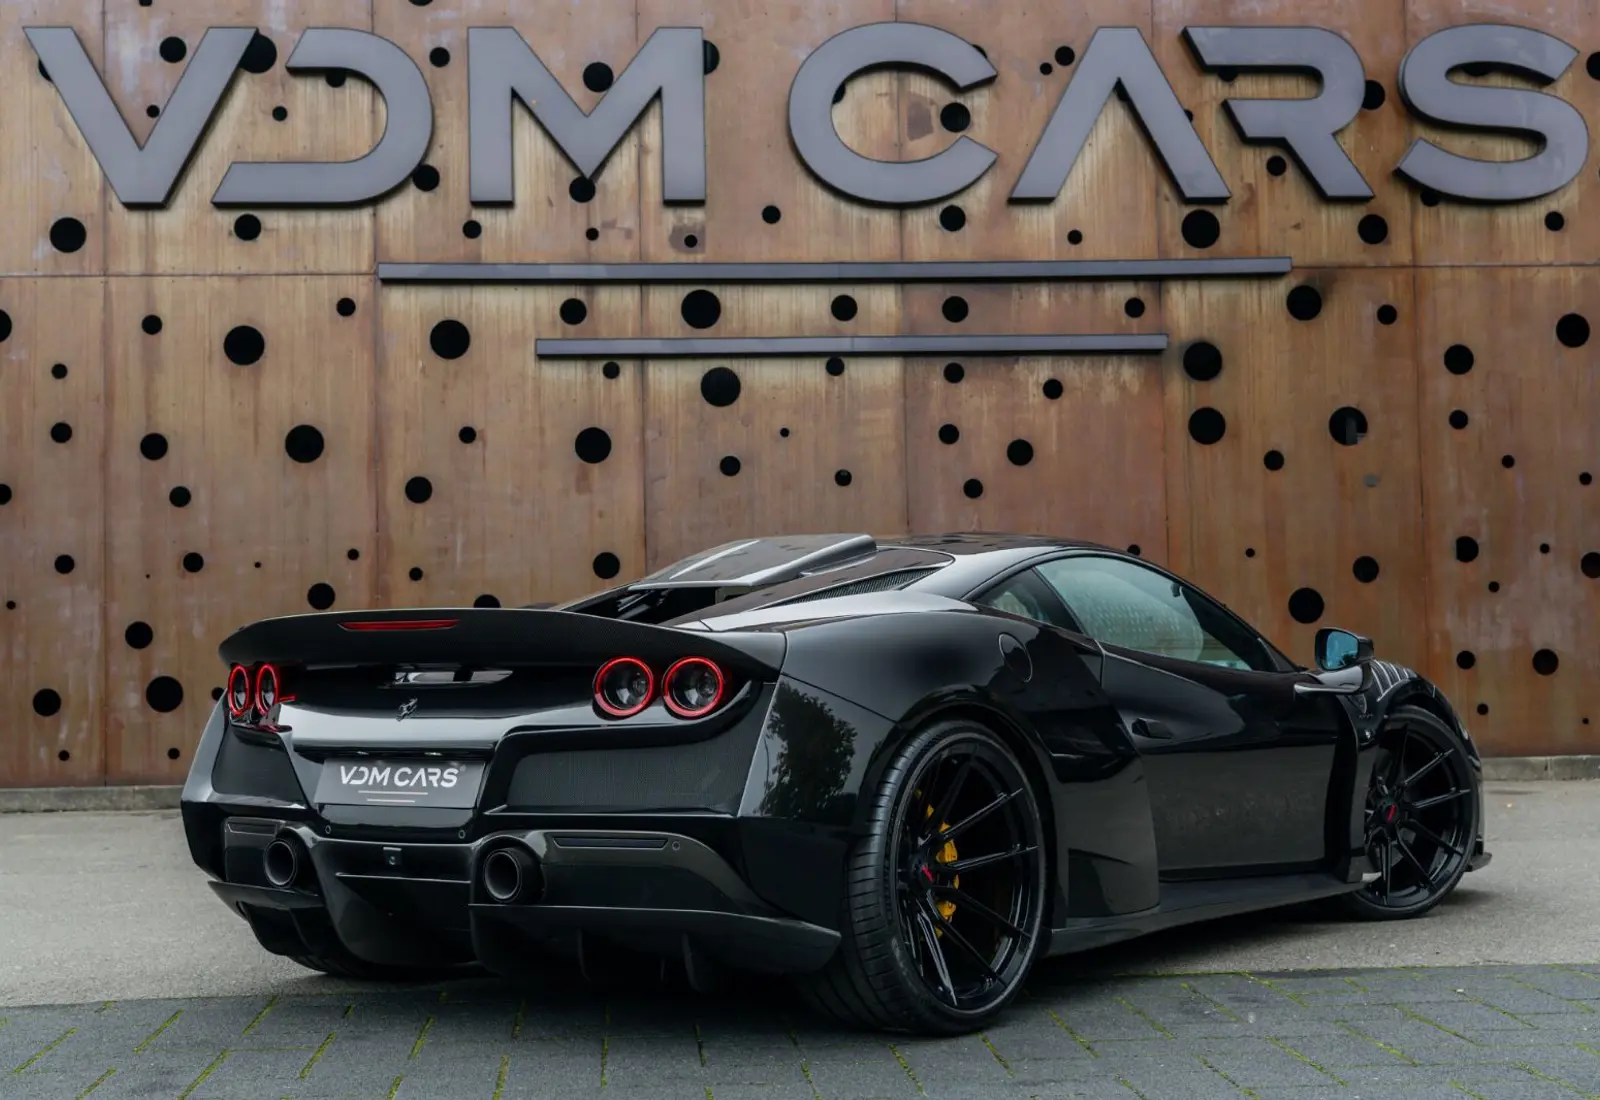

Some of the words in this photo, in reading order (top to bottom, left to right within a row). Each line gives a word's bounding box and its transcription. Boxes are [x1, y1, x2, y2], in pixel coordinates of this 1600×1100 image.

[23, 26, 706, 207] VDM
[788, 21, 1591, 205] CARS
[339, 765, 392, 787] VDM
[393, 766, 460, 788] CARS
